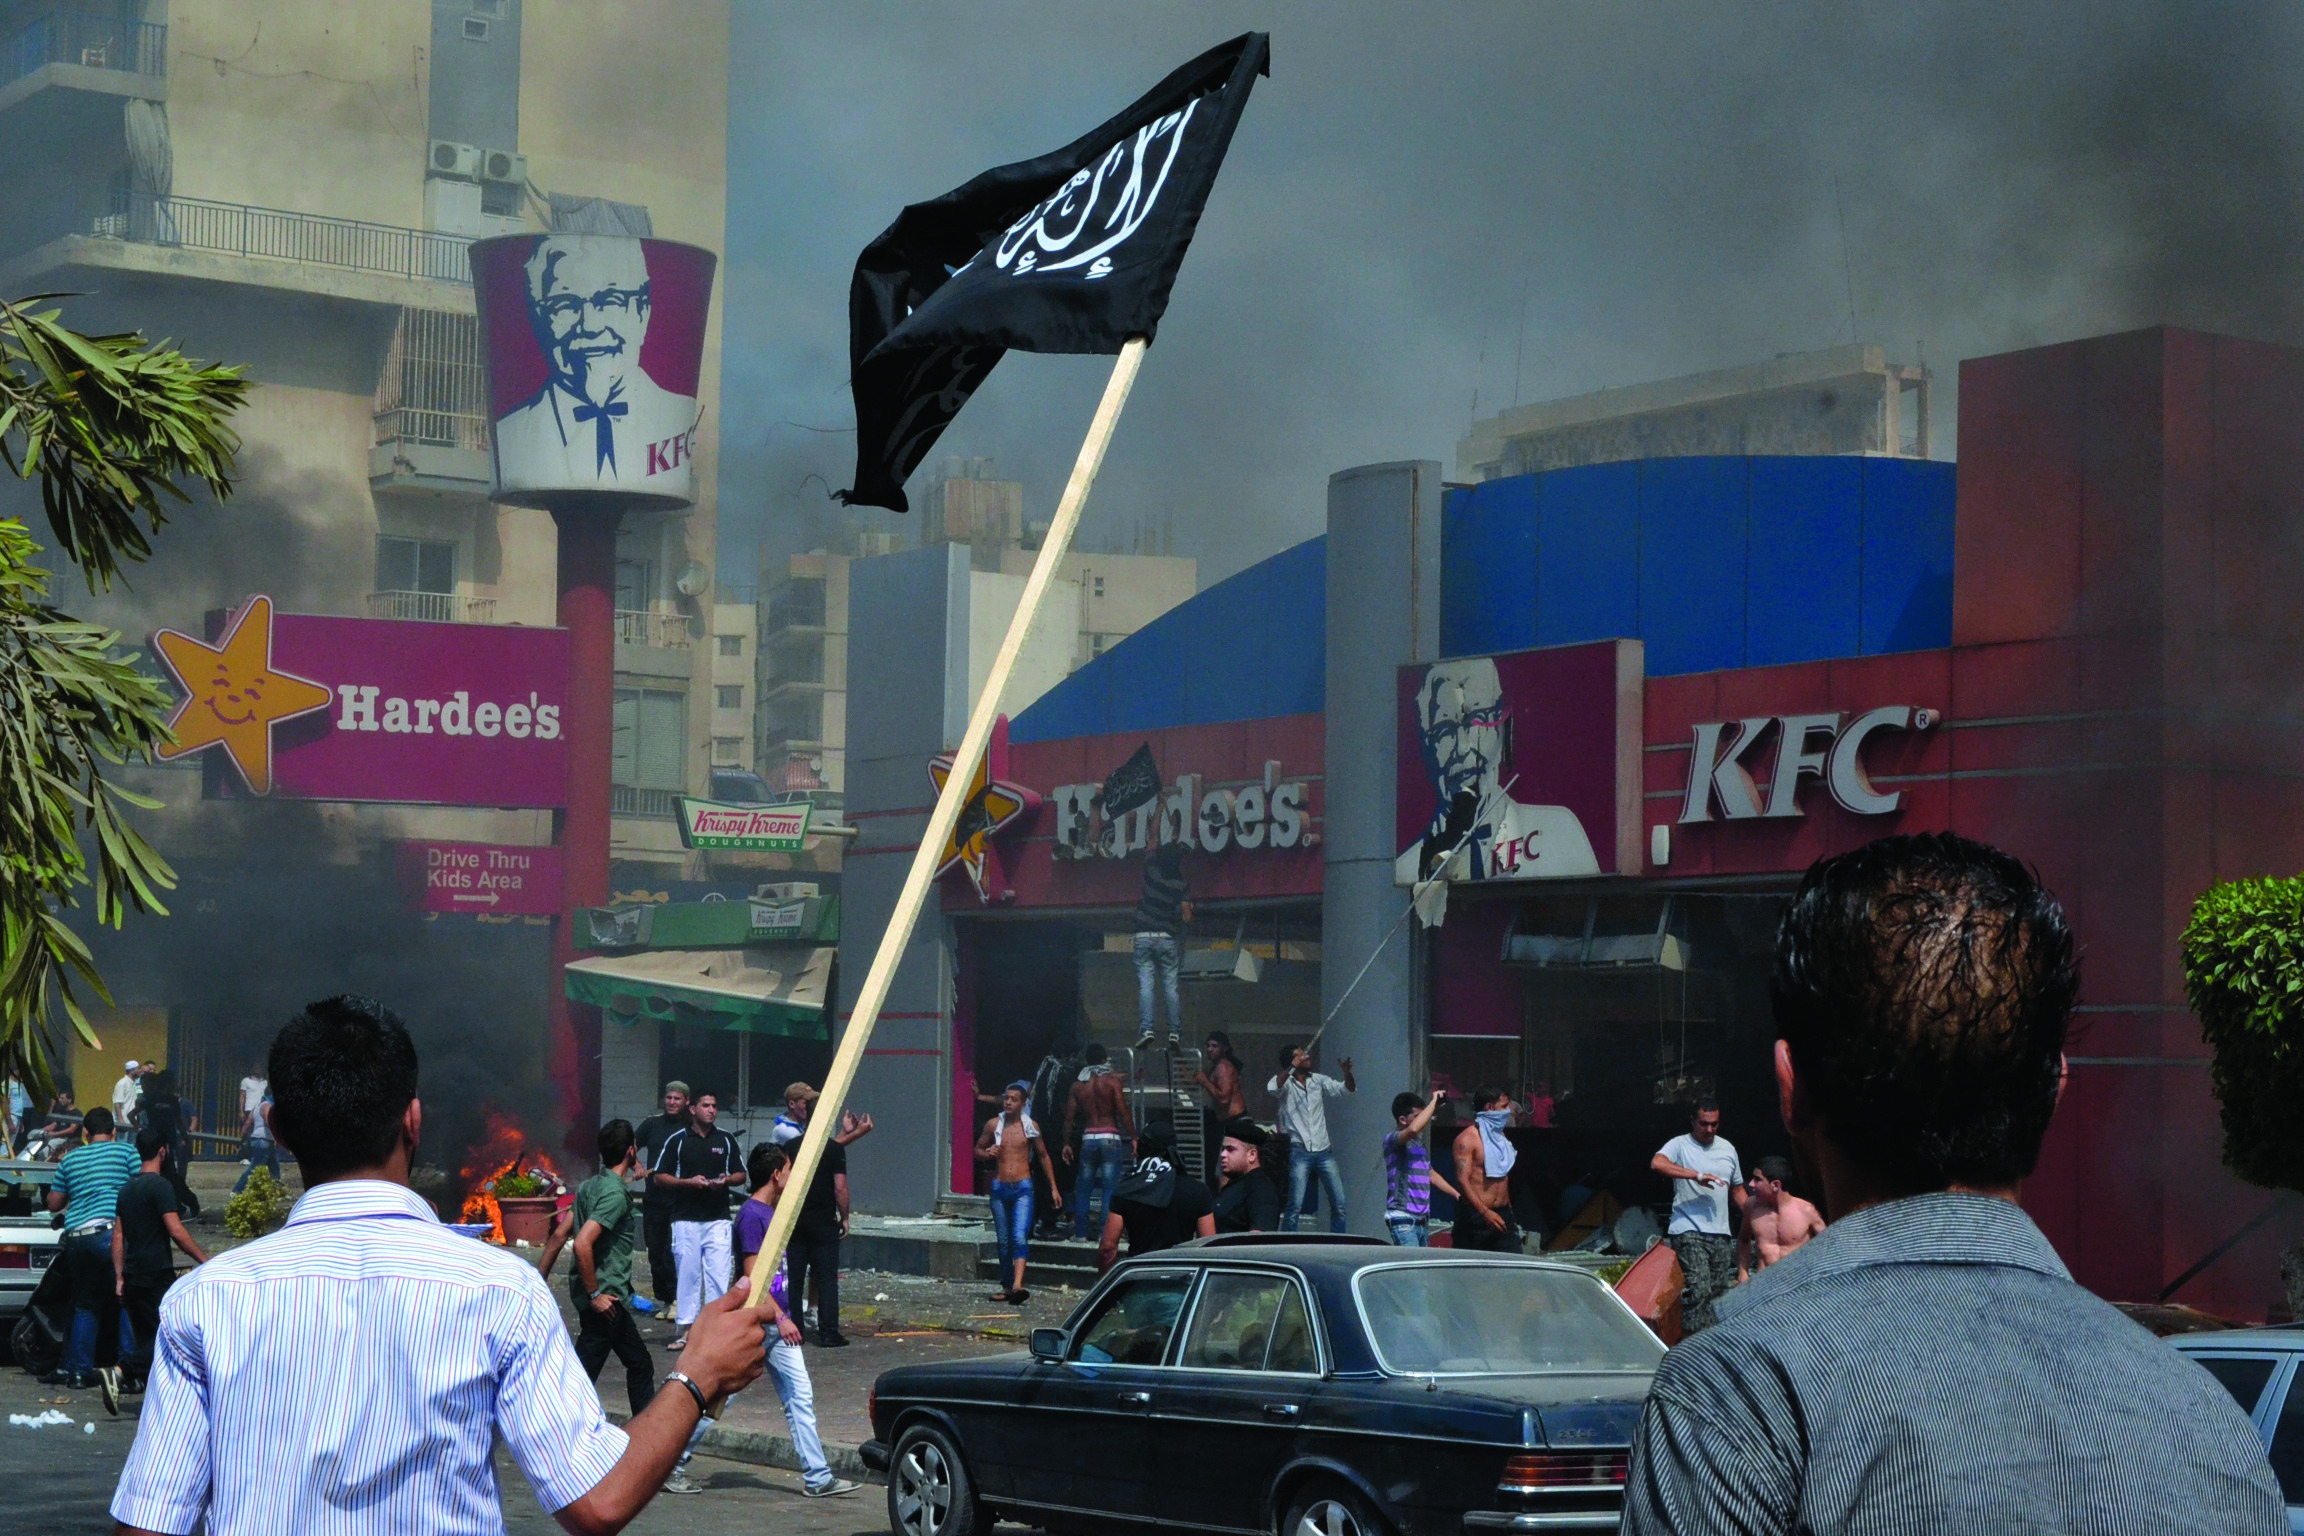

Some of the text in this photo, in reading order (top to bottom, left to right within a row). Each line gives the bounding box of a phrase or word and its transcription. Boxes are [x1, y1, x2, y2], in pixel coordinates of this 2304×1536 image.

[645, 425, 693, 477] KFC
[337, 684, 561, 740] Hardee's
[1677, 705, 1911, 825] KFC
[693, 810, 803, 838] Krispy Kreme
[698, 837, 797, 848] DOUGHNUTS
[428, 848, 529, 869] Drive Thru
[427, 869, 522, 889] Kids Area
